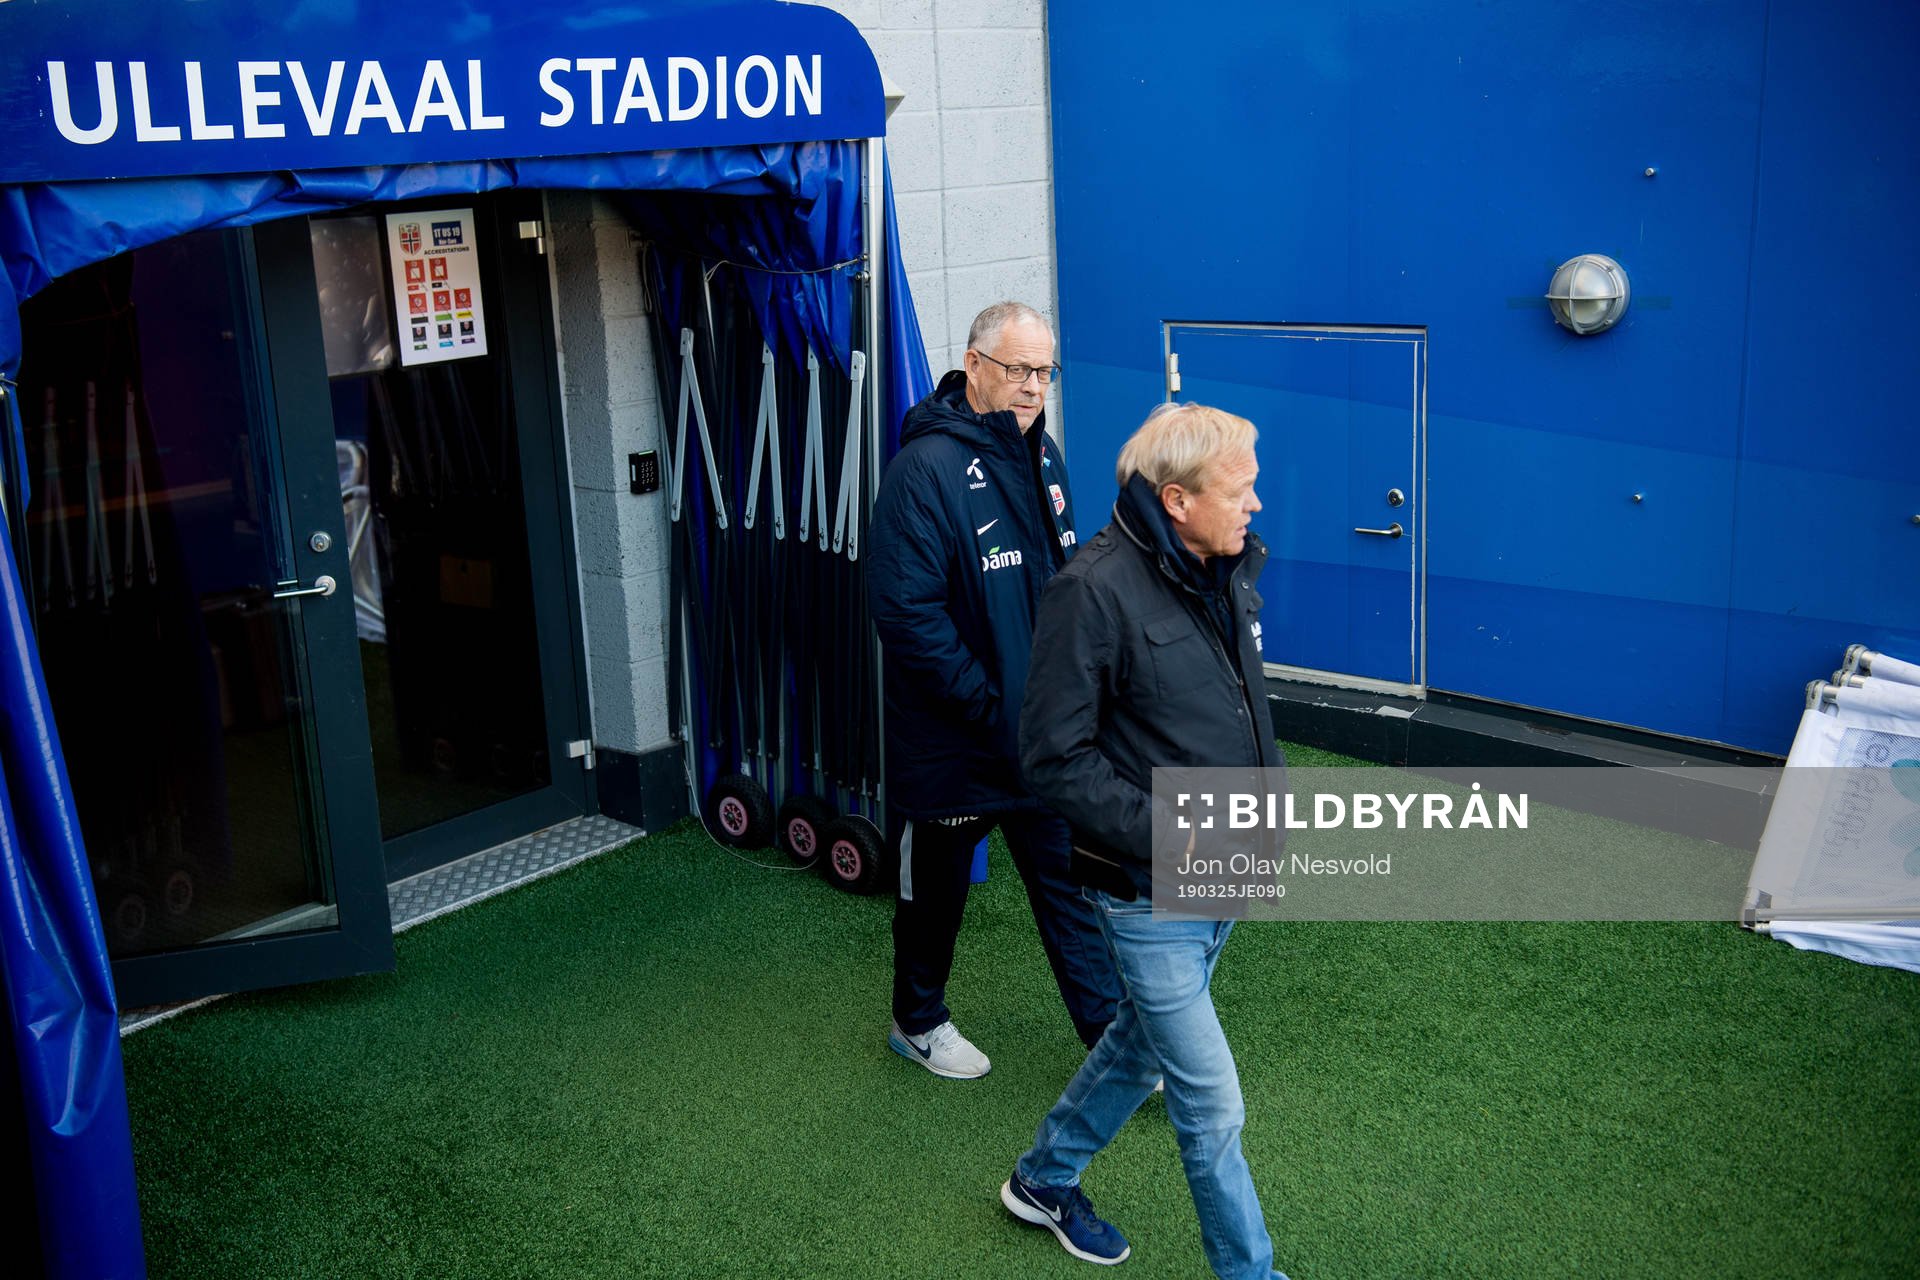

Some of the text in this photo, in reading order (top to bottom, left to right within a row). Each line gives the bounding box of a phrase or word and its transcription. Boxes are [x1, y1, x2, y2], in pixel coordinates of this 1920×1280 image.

[47, 54, 822, 144] ULLEVAAL STADION
[424, 246, 470, 255] ACCREDITATIONS
[969, 481, 987, 490] telenor
